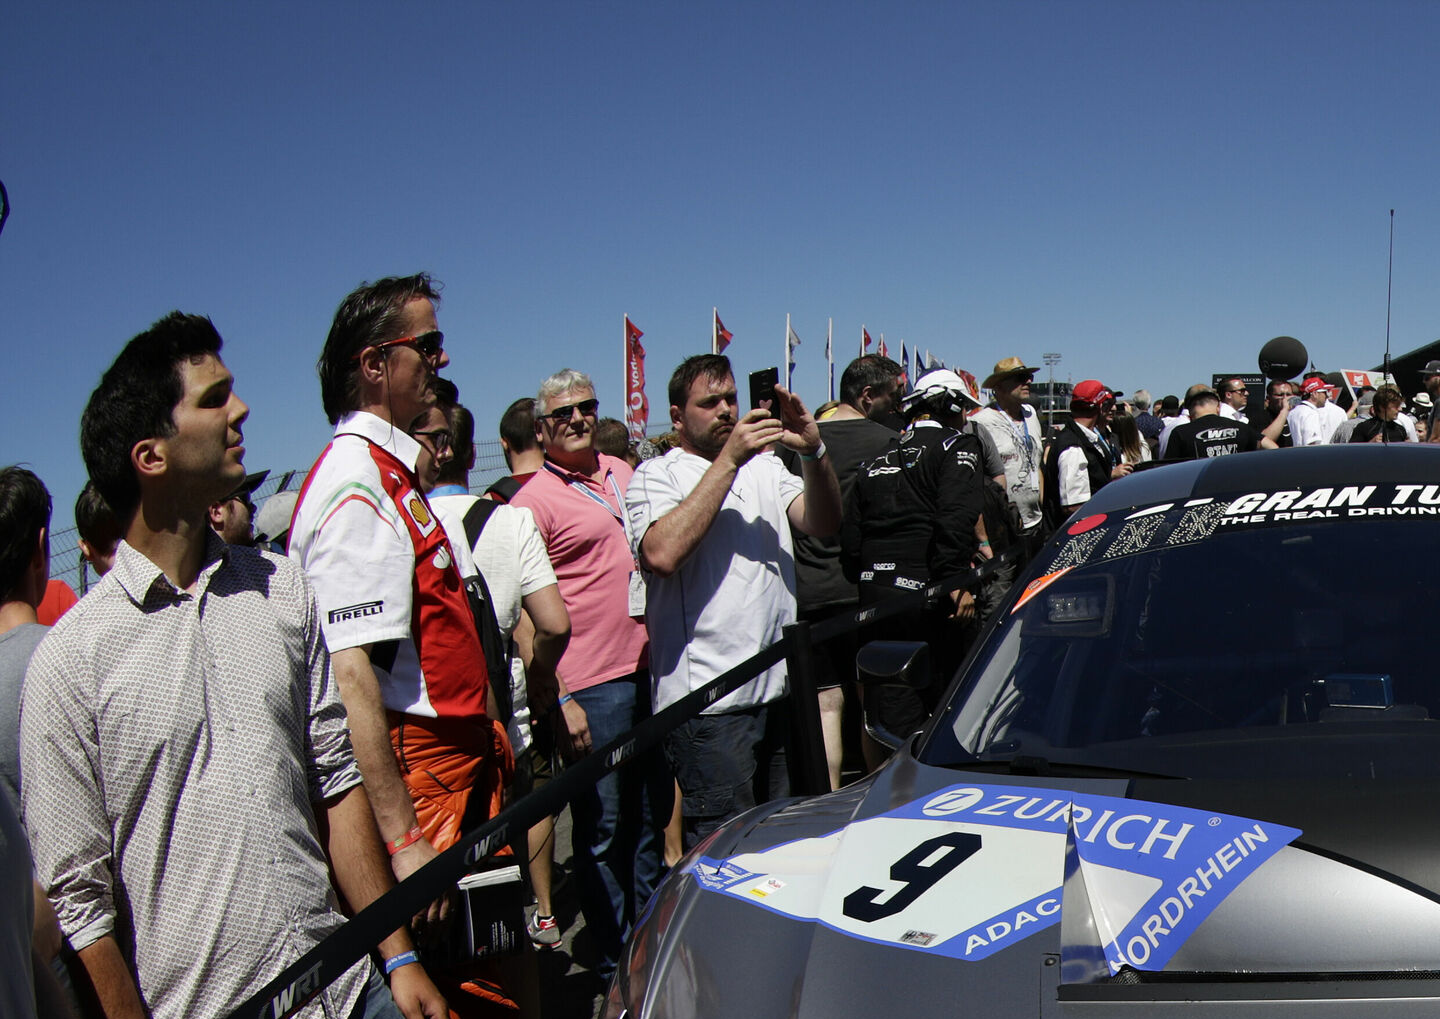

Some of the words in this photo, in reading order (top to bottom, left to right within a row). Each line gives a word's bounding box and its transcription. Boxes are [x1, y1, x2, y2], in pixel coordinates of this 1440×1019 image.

[1221, 514, 1266, 526] THE
[1273, 510, 1339, 521] REAL
[1224, 486, 1377, 516] GRAN
[328, 600, 384, 624] PIRELLI
[973, 795, 1195, 860] ZURICH
[842, 832, 982, 923] 9
[965, 898, 1061, 955] ADAC
